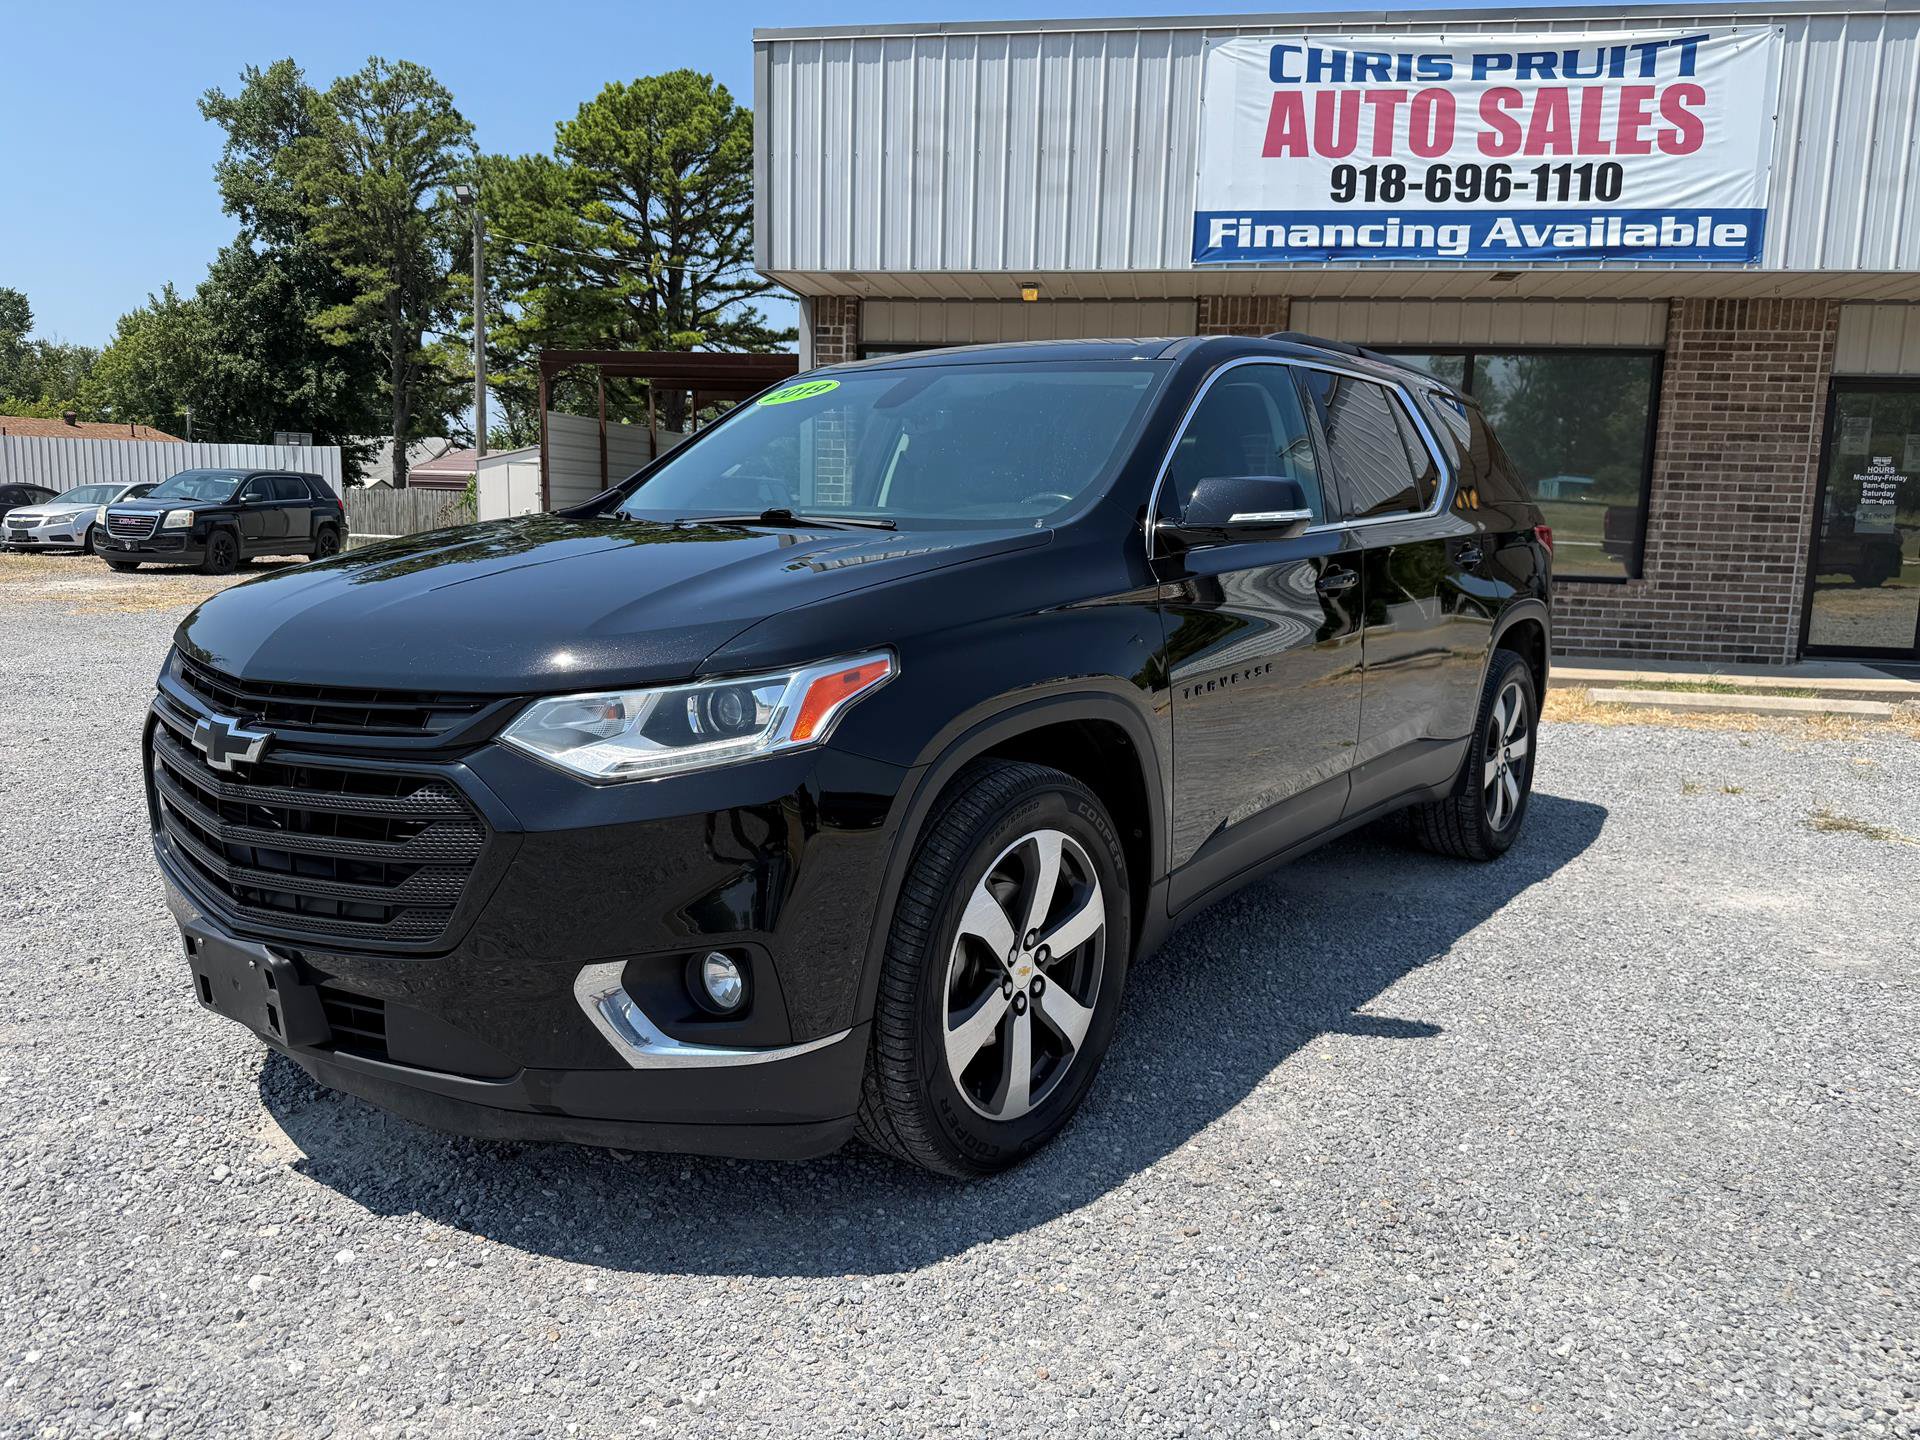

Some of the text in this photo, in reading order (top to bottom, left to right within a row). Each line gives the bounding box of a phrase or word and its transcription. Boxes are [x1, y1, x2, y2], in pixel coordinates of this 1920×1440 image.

[1269, 34, 1710, 84] CHRIS PRUITT
[1261, 83, 1707, 158] AUTO SALES
[1330, 161, 1624, 203] 918-696-1110
[1207, 215, 1748, 256] Financing Available
[1853, 474, 1908, 483] Monday-Friday
[1867, 466, 1896, 475] HOURS
[1862, 489, 1896, 499] Saturday
[1182, 662, 1273, 700] TRAVERSE
[1077, 801, 1123, 871] COOPER
[939, 1095, 1001, 1158] COOPER
